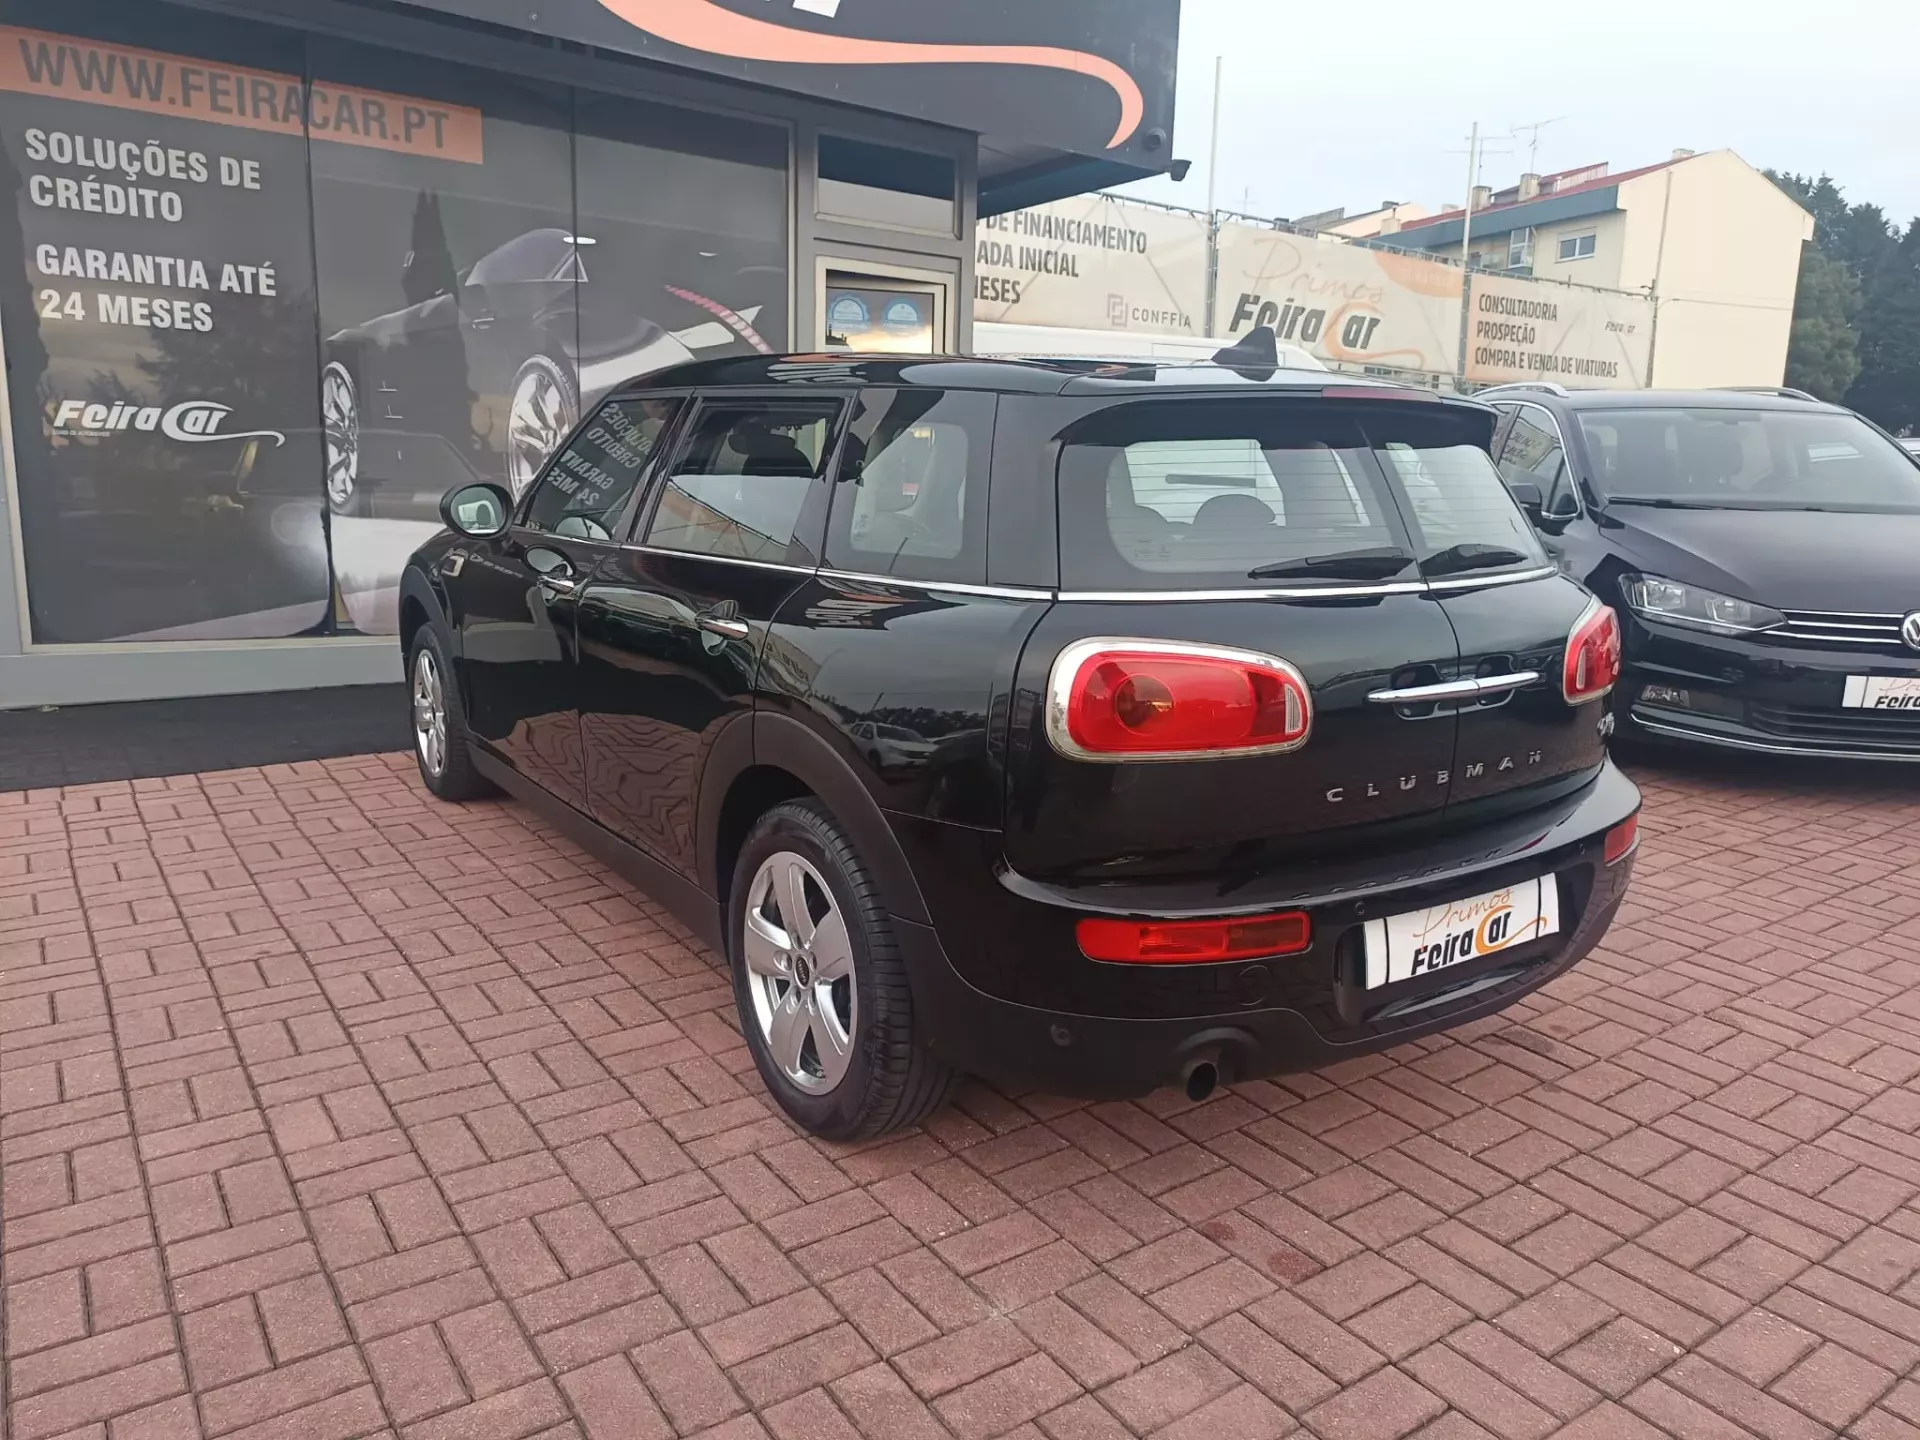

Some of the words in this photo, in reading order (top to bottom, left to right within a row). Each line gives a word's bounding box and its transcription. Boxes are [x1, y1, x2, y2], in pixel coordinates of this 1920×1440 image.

[18, 38, 449, 149] WWW.FEIRACAR.PT
[25, 128, 208, 183] SOLUÇÕES
[220, 157, 261, 190] DE
[29, 174, 183, 223] CRÉDITO
[1013, 210, 1147, 254] FINANCIAMENTO
[36, 244, 210, 290] GARANTIA
[220, 261, 277, 297] ATÉ
[1019, 246, 1079, 278] INICIAL
[1242, 236, 1386, 304] Primos
[40, 289, 86, 321] 24
[97, 293, 213, 332] MESES
[974, 275, 1021, 304] ESES
[1479, 293, 1557, 321] CONSULTADORIA
[1131, 307, 1191, 328] CONFFIA
[1477, 320, 1535, 346] PROSPEÇÃO
[1475, 347, 1516, 369] COMPRA
[1519, 352, 1525, 369] E
[1527, 353, 1559, 373] VENDA
[1561, 356, 1573, 374] DE
[1575, 358, 1618, 378] VIATURAS
[1326, 750, 1541, 802] CLUBMAN
